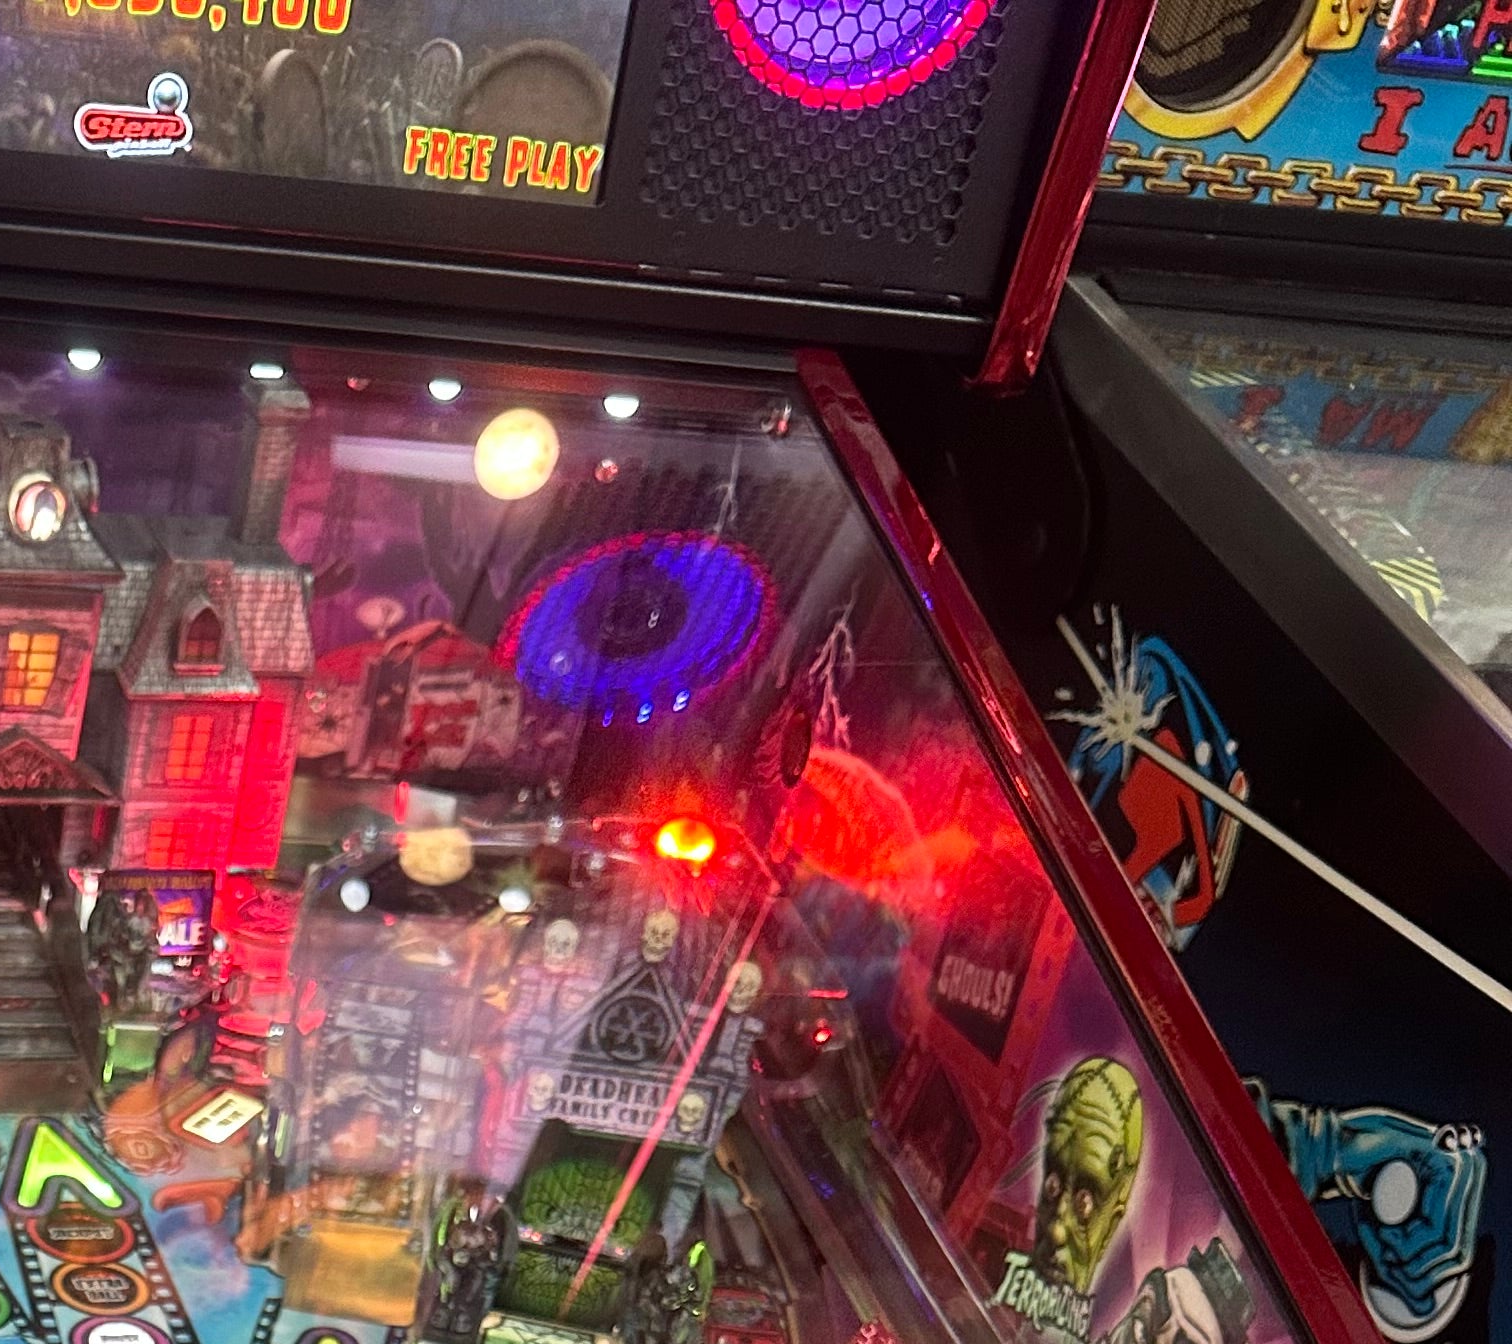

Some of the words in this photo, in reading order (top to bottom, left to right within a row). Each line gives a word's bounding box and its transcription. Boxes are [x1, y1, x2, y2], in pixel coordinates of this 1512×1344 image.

[86, 114, 181, 140] Stern
[1358, 86, 1425, 156] I
[403, 126, 492, 182] FREE
[503, 137, 603, 192] PLAY
